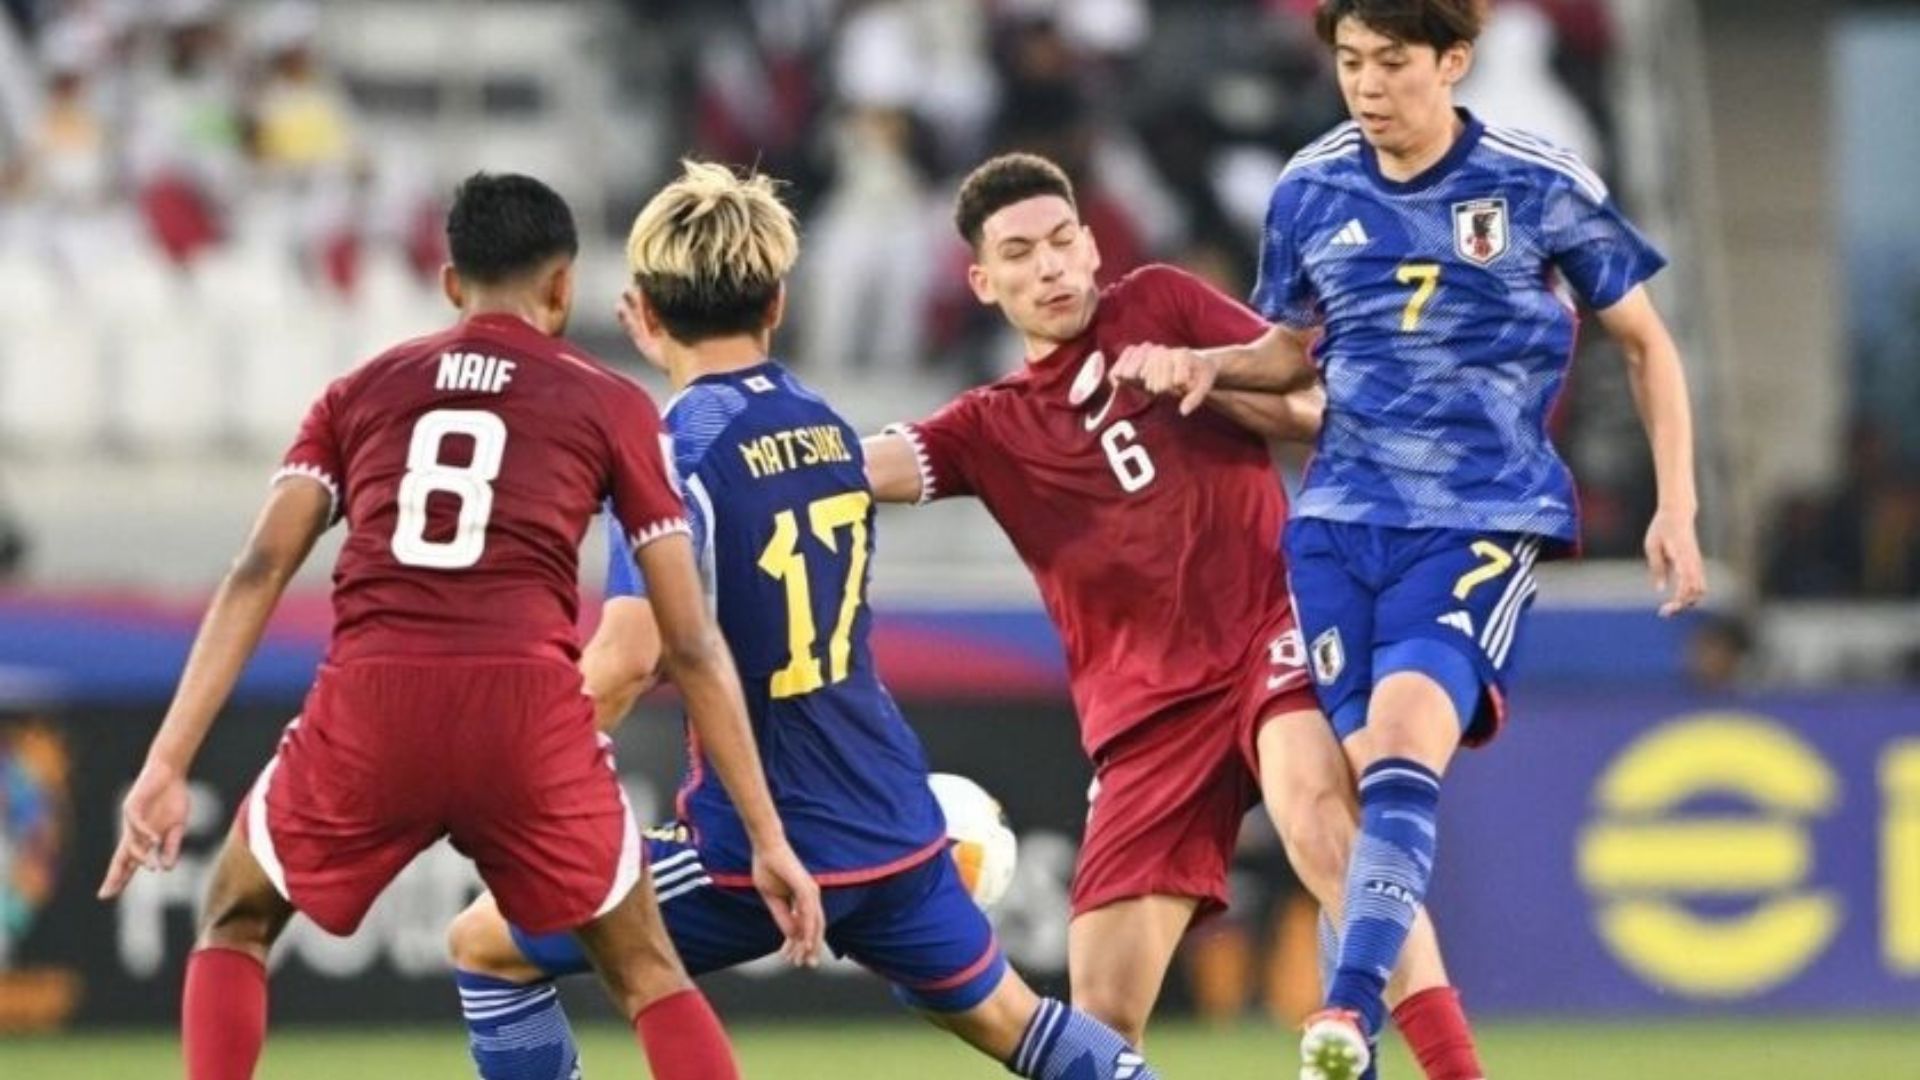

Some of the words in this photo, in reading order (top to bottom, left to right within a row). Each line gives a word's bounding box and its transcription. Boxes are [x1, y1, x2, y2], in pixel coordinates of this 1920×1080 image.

[1396, 263, 1440, 332] 7
[435, 352, 517, 394] NAIF
[738, 424, 852, 479] MATSUKI
[1101, 420, 1156, 493] 6
[391, 407, 508, 569] 8
[757, 491, 871, 699] 17
[1453, 540, 1513, 601] 7
